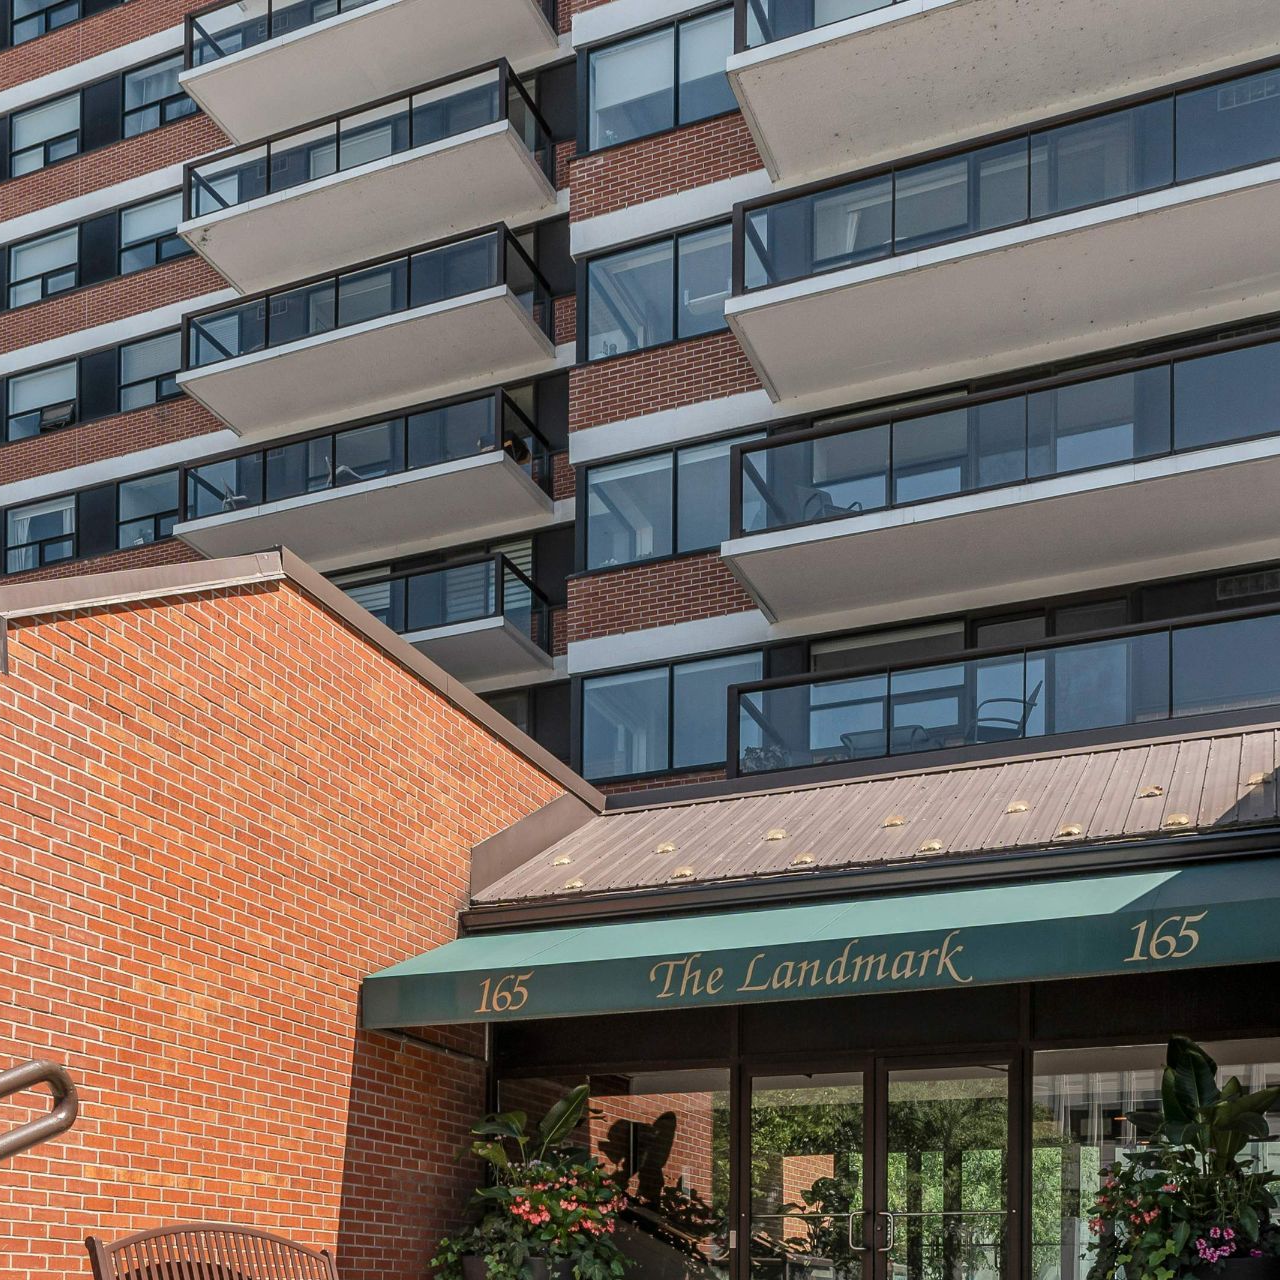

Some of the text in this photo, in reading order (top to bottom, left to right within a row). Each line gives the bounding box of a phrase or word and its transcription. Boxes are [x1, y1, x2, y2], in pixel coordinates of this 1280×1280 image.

[1123, 909, 1209, 962] 165
[650, 930, 973, 999] The Landmark
[475, 971, 535, 1014] 165
